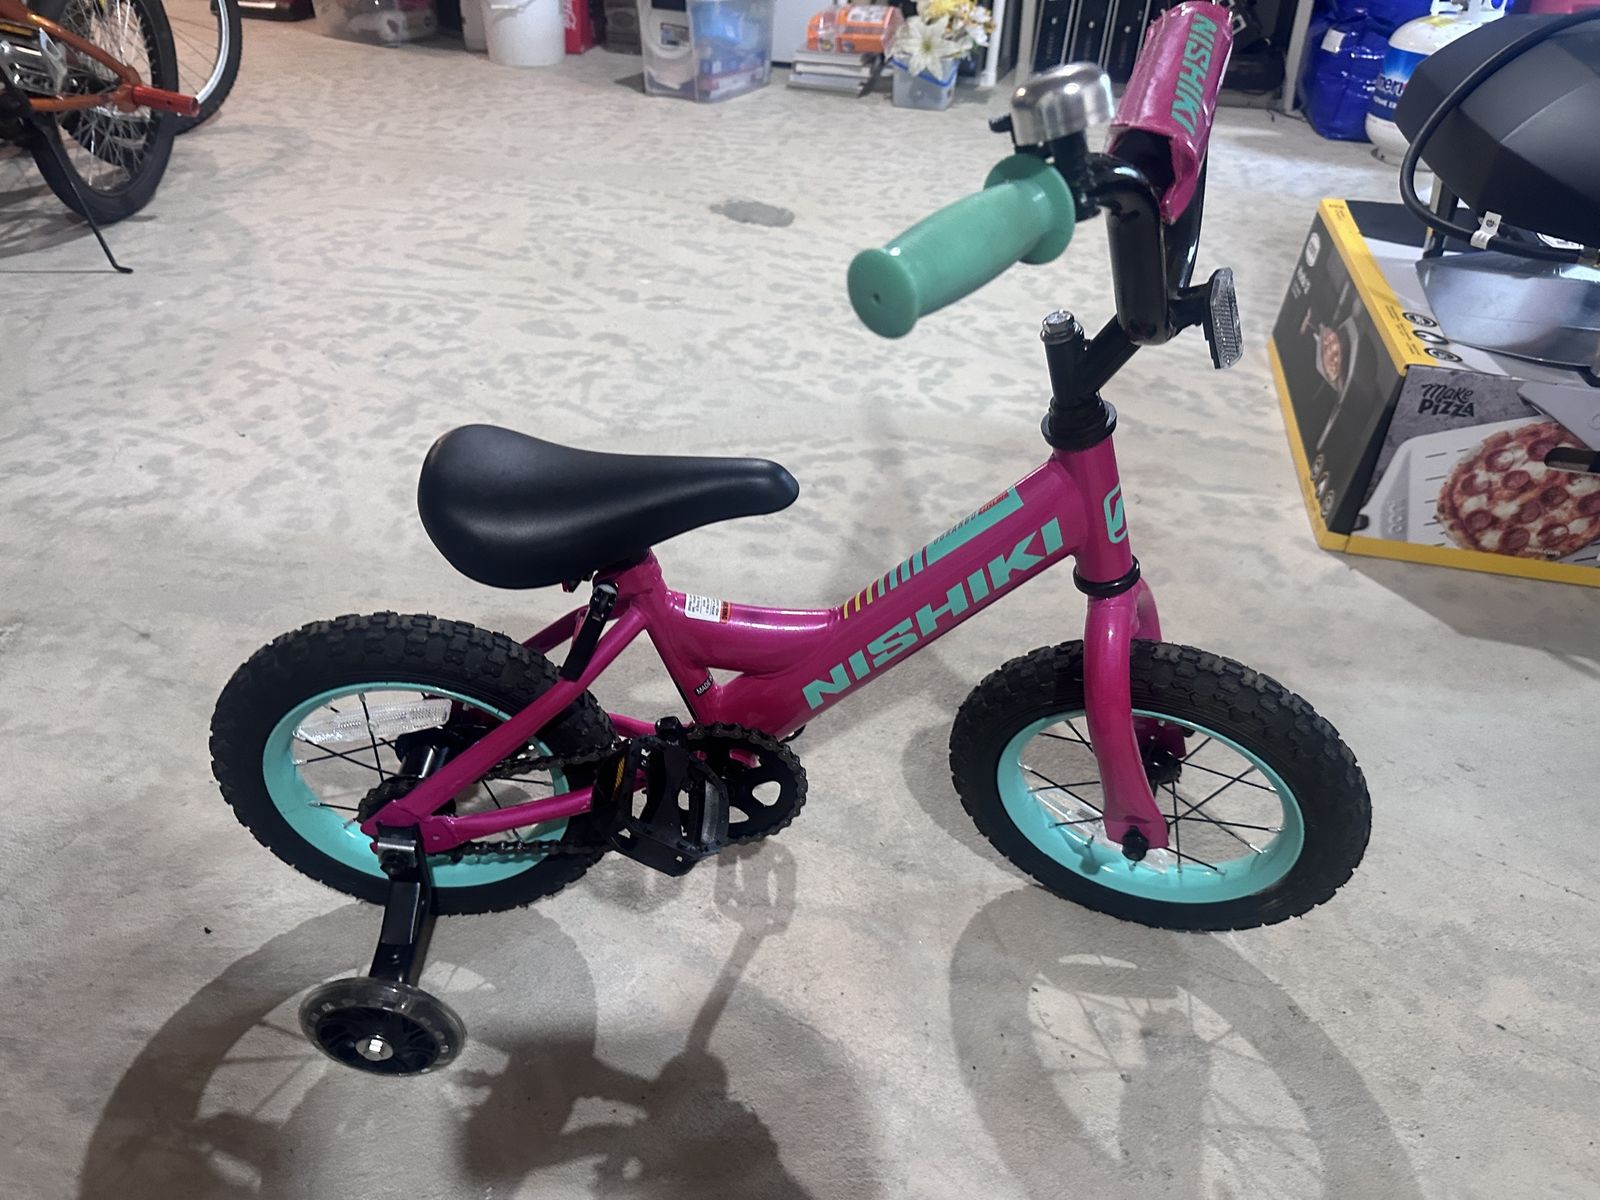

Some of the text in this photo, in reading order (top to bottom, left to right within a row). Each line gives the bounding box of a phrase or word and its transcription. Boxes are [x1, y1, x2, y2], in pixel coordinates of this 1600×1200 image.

[1170, 12, 1217, 137] NISHIKI
[1421, 383, 1475, 404] Make
[802, 517, 1064, 709] NISHIKI
[696, 679, 711, 695] MADE
